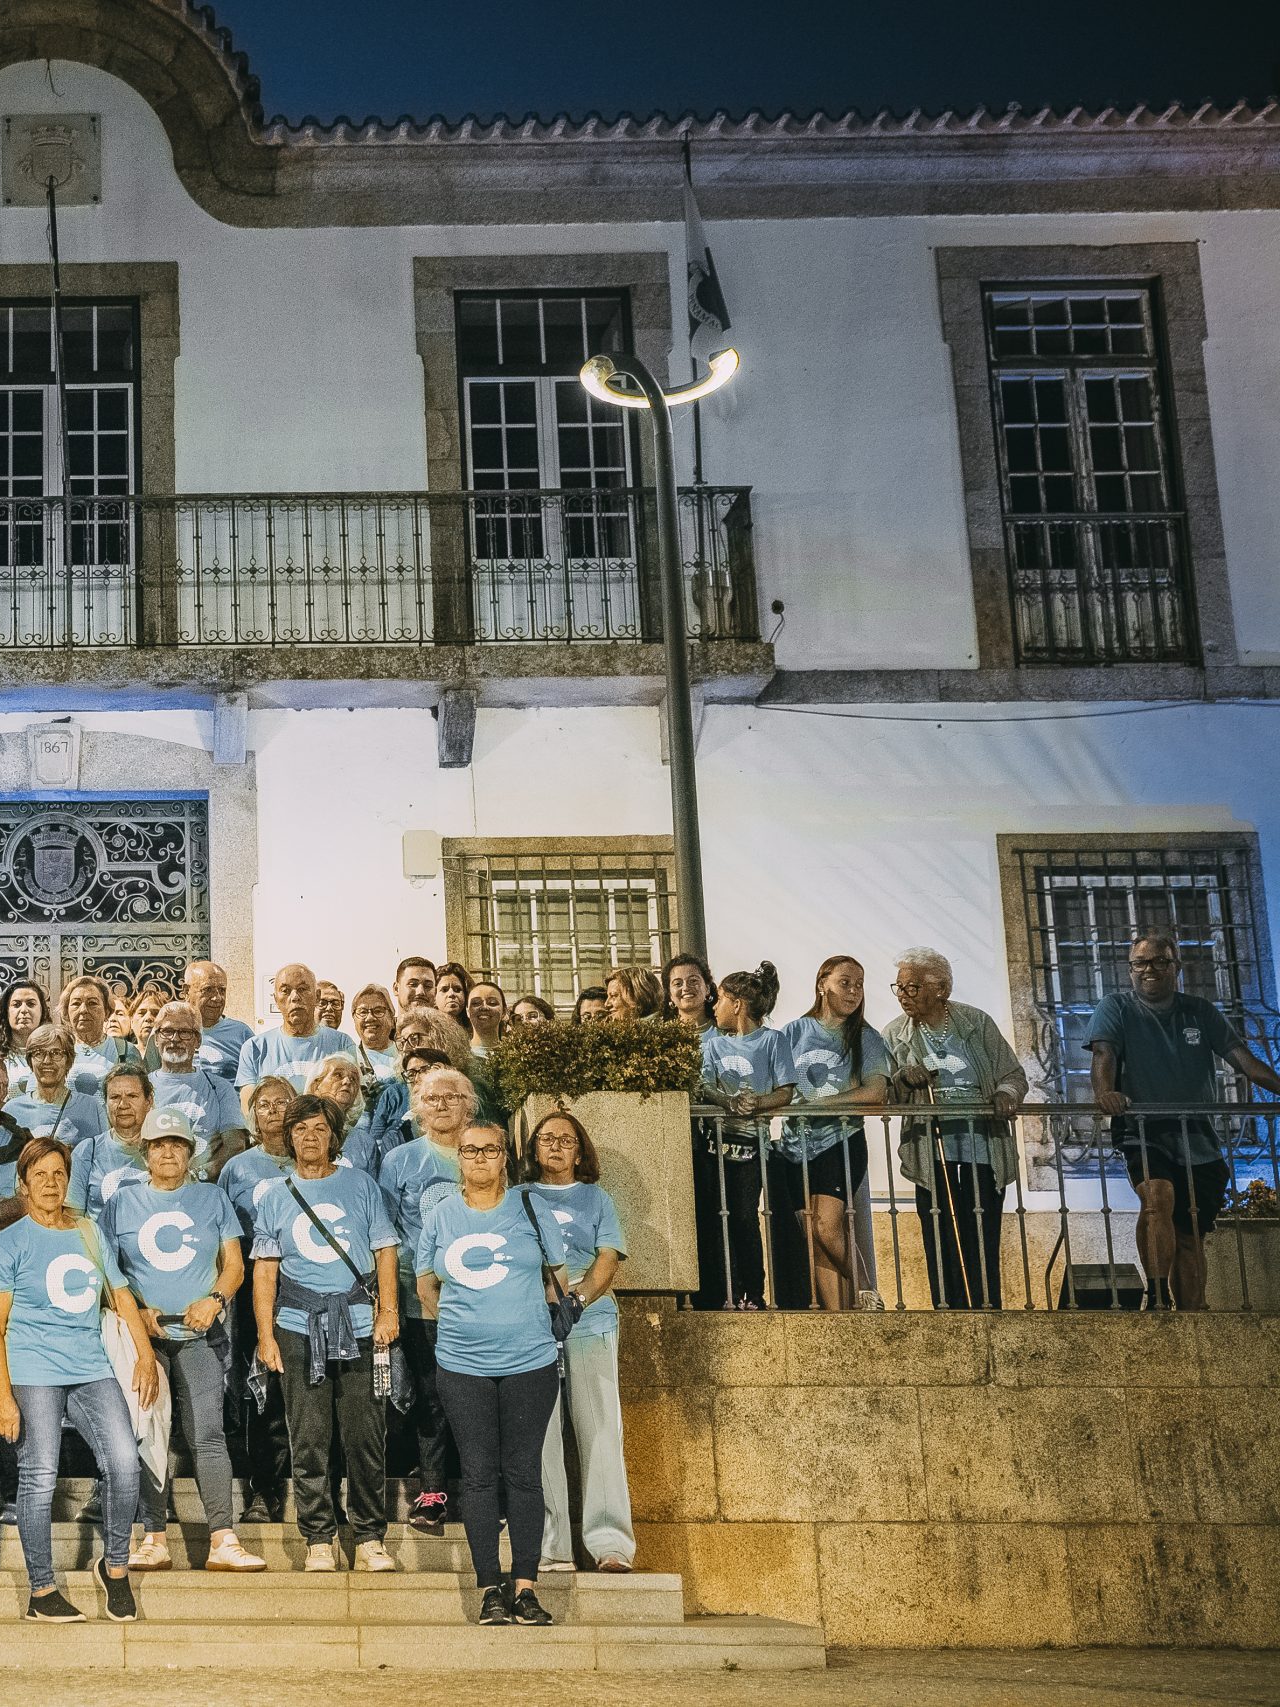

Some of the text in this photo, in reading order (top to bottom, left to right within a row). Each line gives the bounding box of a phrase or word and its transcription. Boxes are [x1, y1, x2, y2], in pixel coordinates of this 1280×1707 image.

[40, 741, 68, 754] 1867
[138, 1211, 197, 1272] C
[445, 1233, 510, 1289] C
[46, 1254, 98, 1314] C
